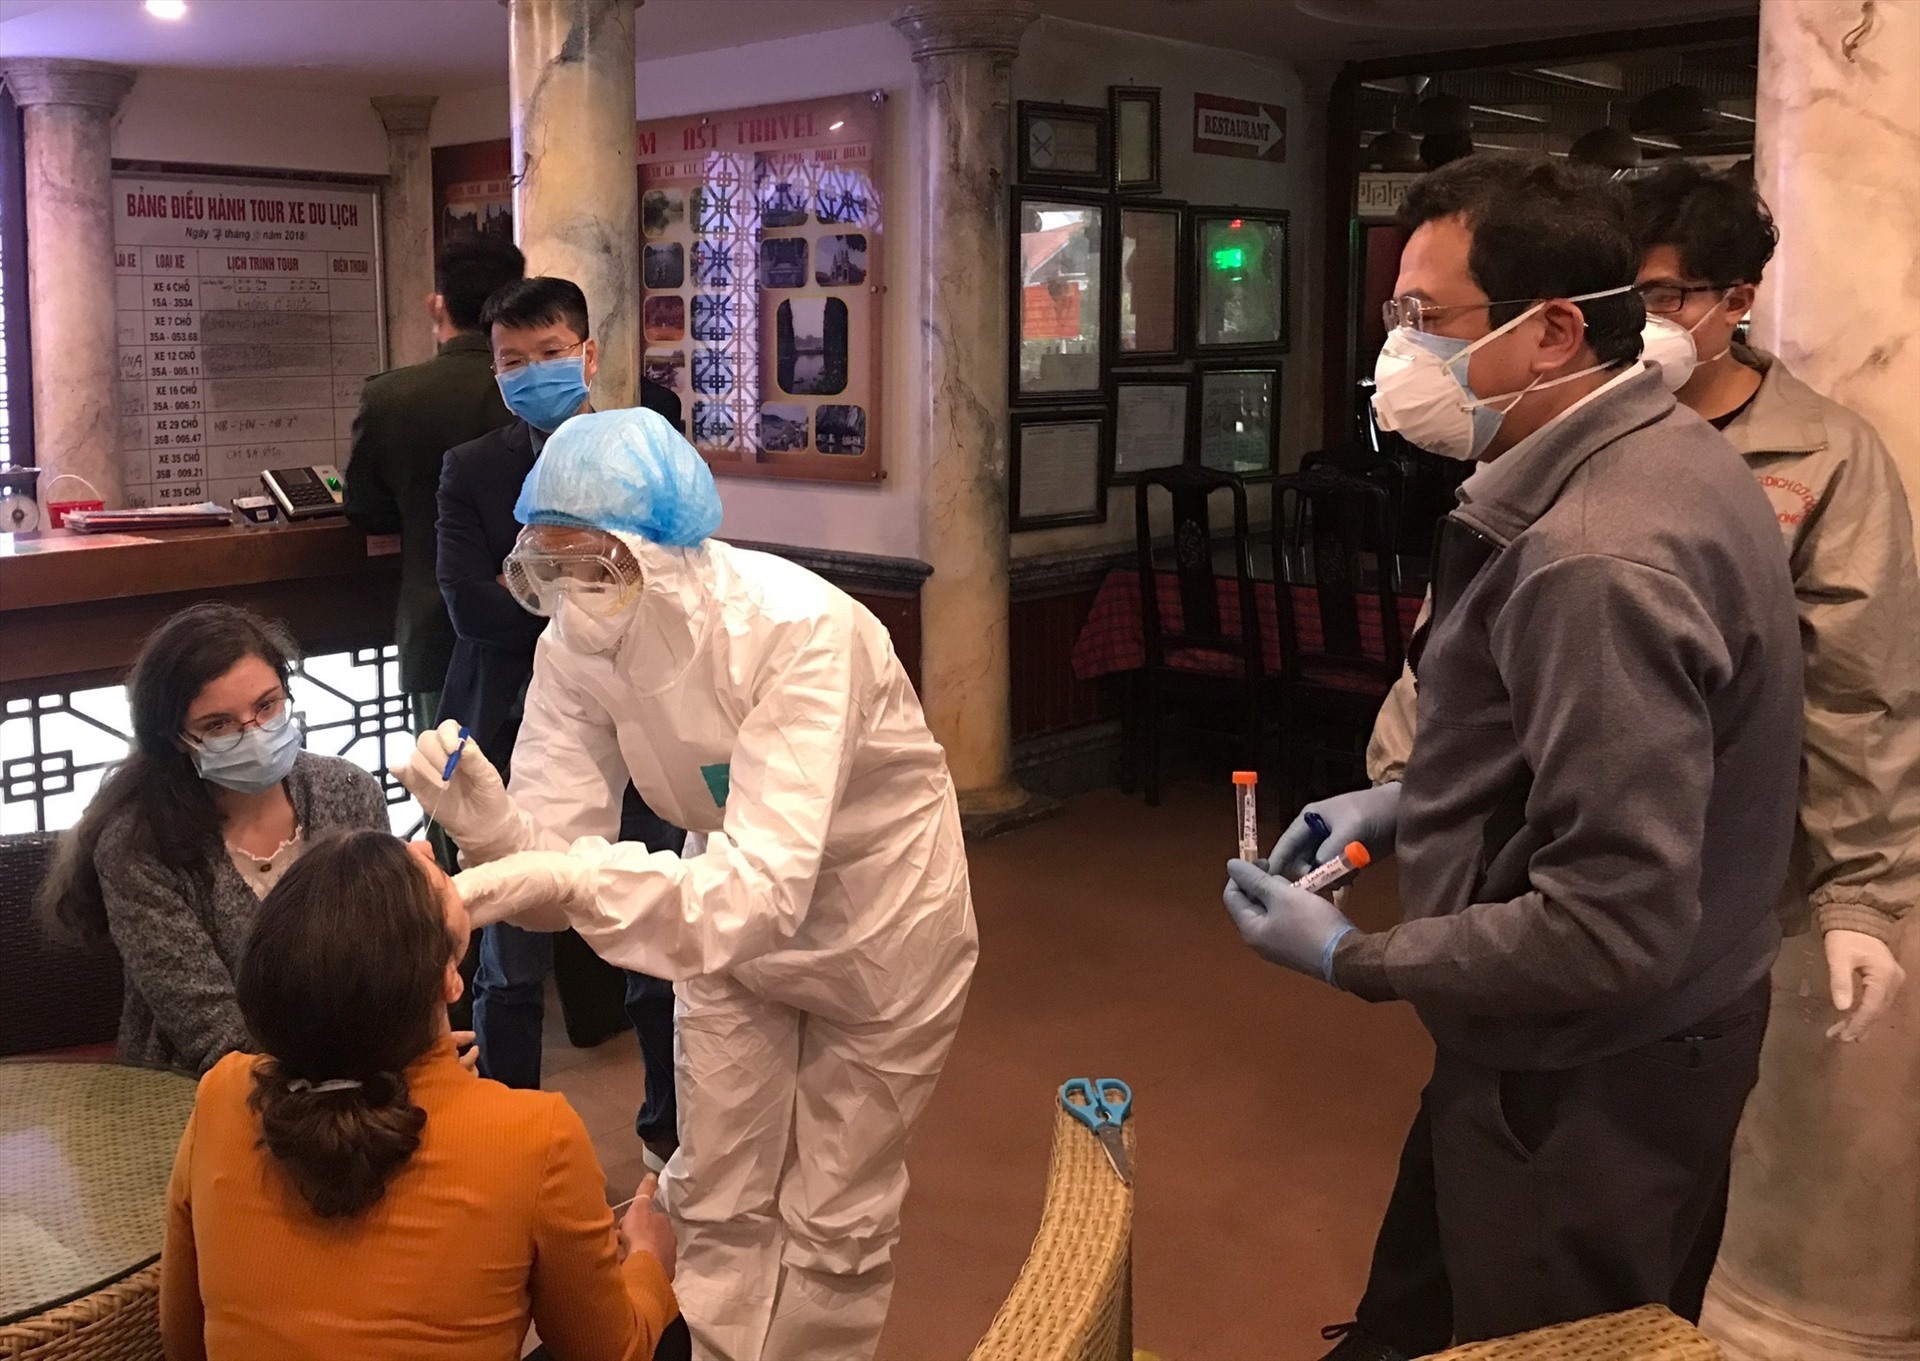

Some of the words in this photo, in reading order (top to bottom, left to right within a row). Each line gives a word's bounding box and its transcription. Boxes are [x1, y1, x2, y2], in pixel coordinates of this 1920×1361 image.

[735, 112, 818, 144] TRAVEL
[1204, 115, 1270, 141] RESTAURANT
[127, 186, 167, 218] BẢNG
[207, 192, 246, 221] HÀNH
[250, 199, 285, 223] TOUR
[288, 201, 306, 224] XE
[309, 202, 326, 225] DU
[330, 203, 358, 230] LỊCH
[185, 227, 210, 239] Ngày
[224, 229, 250, 241] tháng
[263, 230, 282, 240] năm
[127, 253, 137, 268] XE
[155, 254, 173, 271] LOẠI
[174, 254, 185, 269] XE
[227, 255, 247, 273] LỊCH
[249, 253, 275, 271] TRÌNH
[277, 257, 299, 271] TOUR
[153, 282, 164, 292] XE
[155, 316, 165, 326] XE
[154, 351, 165, 361] XE
[156, 386, 166, 396] XE
[157, 421, 168, 430] XE
[159, 455, 169, 464] XE
[160, 489, 170, 498] XE
[172, 488, 182, 497] 35
